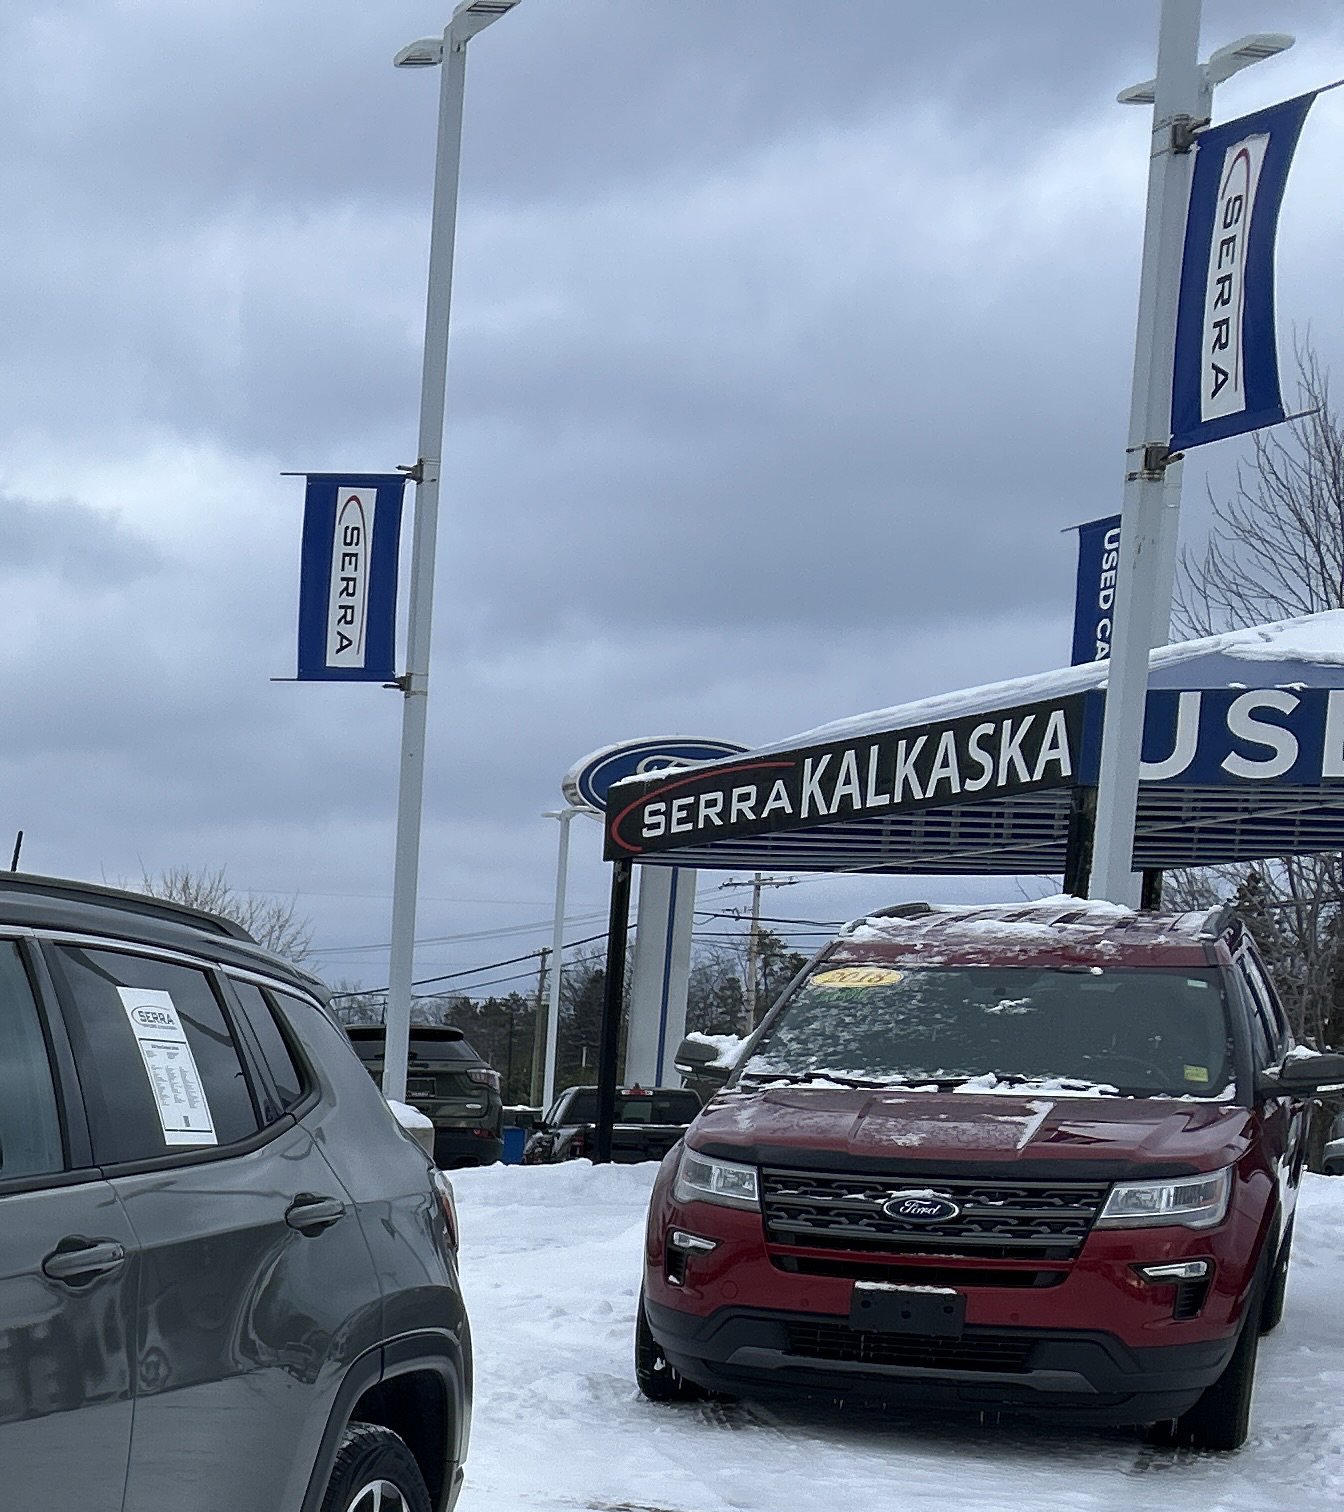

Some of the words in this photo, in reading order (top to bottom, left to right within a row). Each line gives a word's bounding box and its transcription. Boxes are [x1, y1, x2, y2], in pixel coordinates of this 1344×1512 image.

[1211, 194, 1242, 400] SERRA
[335, 525, 360, 655] SERRA
[1099, 527, 1121, 611] USED
[641, 779, 794, 838] SERRA
[800, 709, 1073, 819] KALKASKA
[1139, 688, 1344, 780] US
[137, 1010, 176, 1025] SERRA
[899, 1199, 942, 1215] Ford
